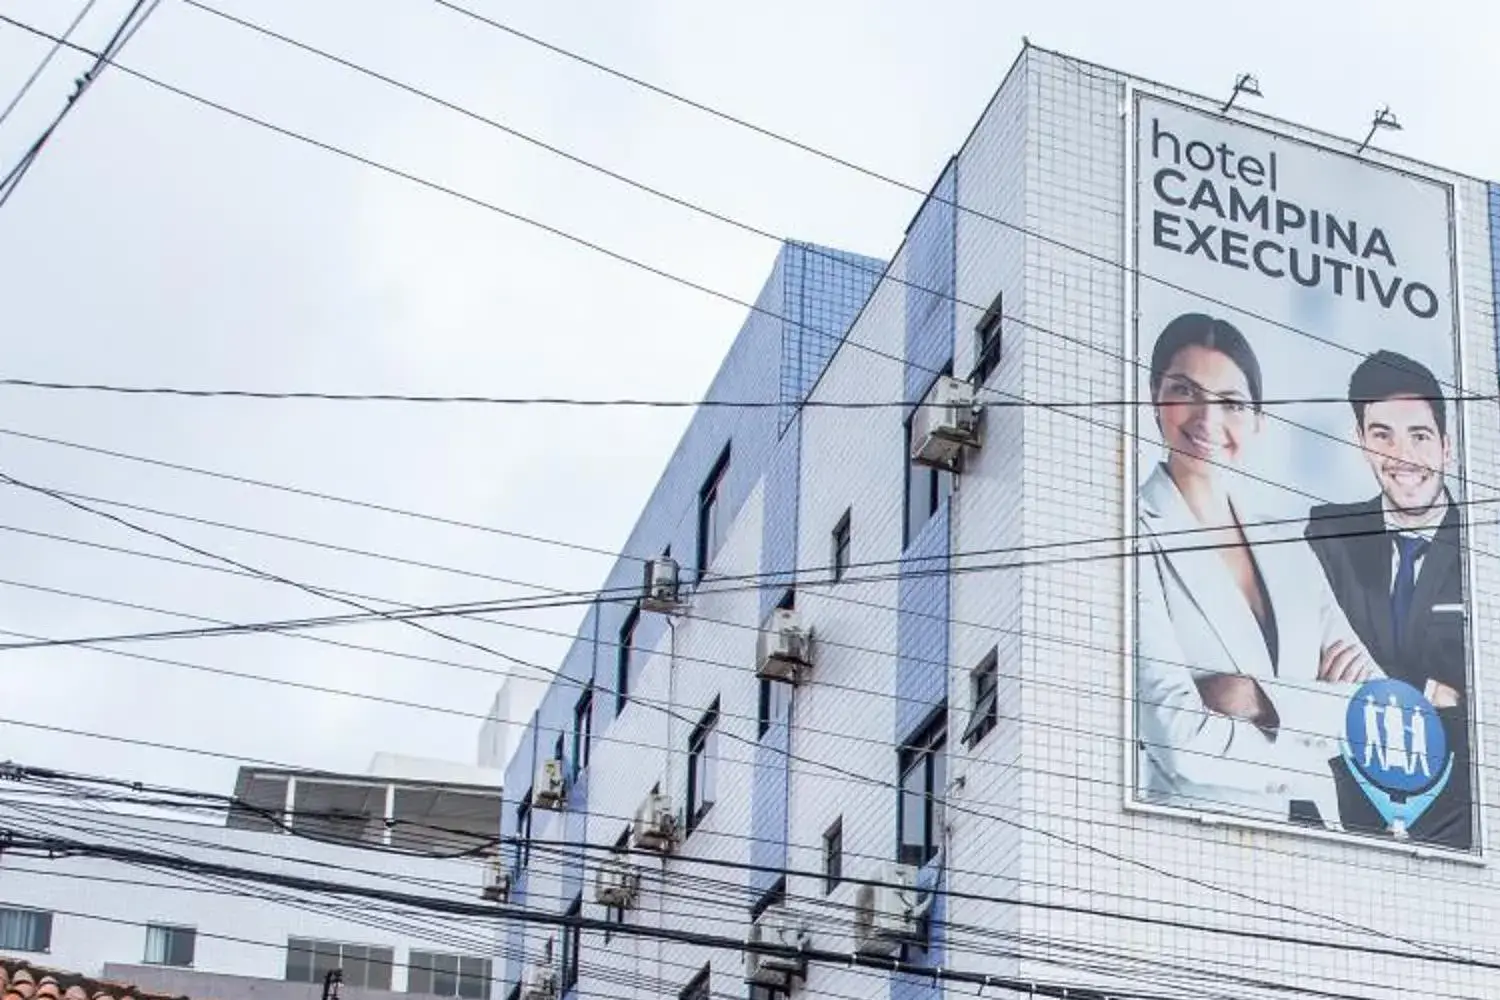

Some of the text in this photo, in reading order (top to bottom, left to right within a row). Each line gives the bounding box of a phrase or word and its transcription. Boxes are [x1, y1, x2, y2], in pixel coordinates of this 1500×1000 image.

[1152, 118, 1276, 191] hotel
[1153, 167, 1397, 267] CAMPINA
[1153, 209, 1439, 319] EXECUTIVO
